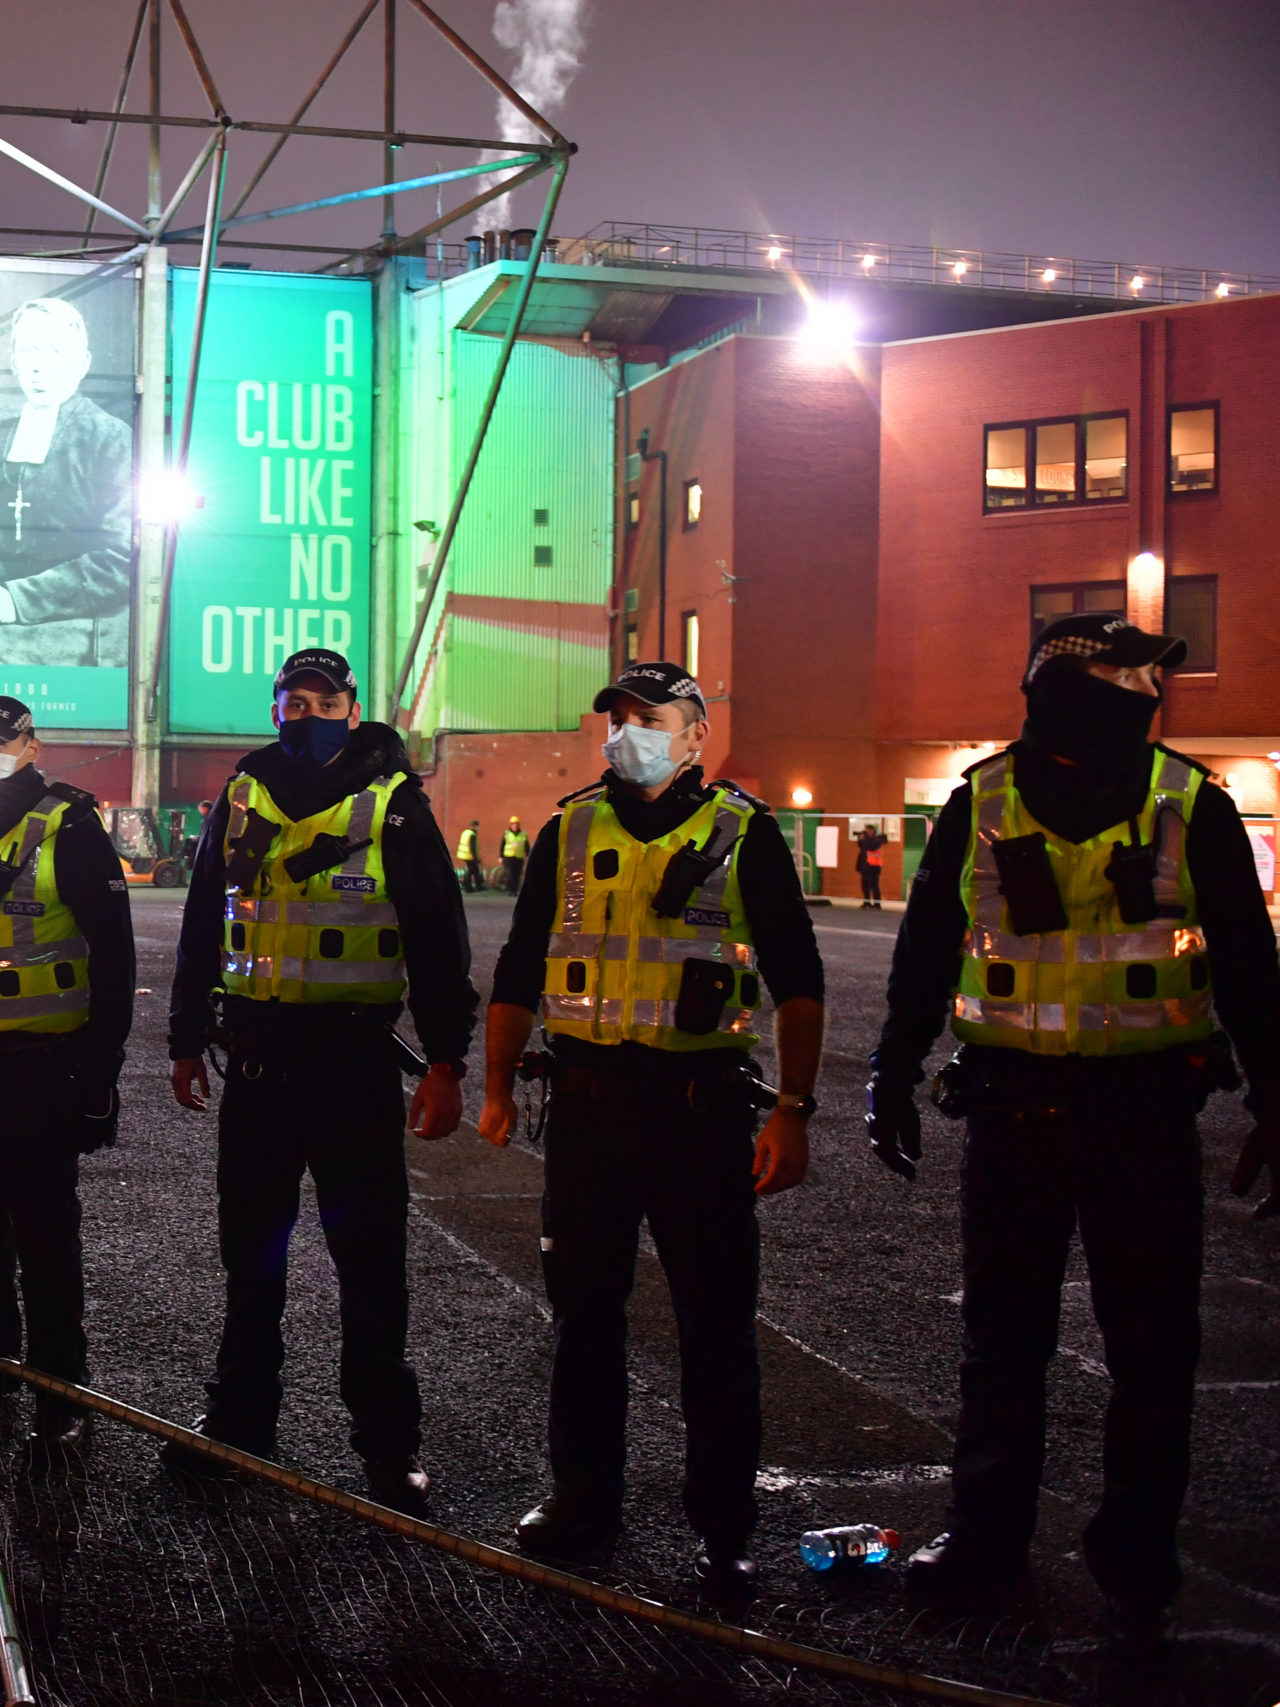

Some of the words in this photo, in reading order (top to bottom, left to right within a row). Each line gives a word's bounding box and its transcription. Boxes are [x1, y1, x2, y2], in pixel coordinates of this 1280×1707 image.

[325, 310, 354, 377] A
[236, 379, 354, 452] CLUB
[260, 456, 354, 527] LIKE
[290, 533, 352, 602] NO
[202, 605, 352, 675] OTHER
[293, 656, 339, 667] POLICE
[617, 668, 666, 682] POLICE
[335, 877, 375, 892] POLICE
[6, 902, 42, 914] POLICE
[687, 910, 728, 926] POLICE
